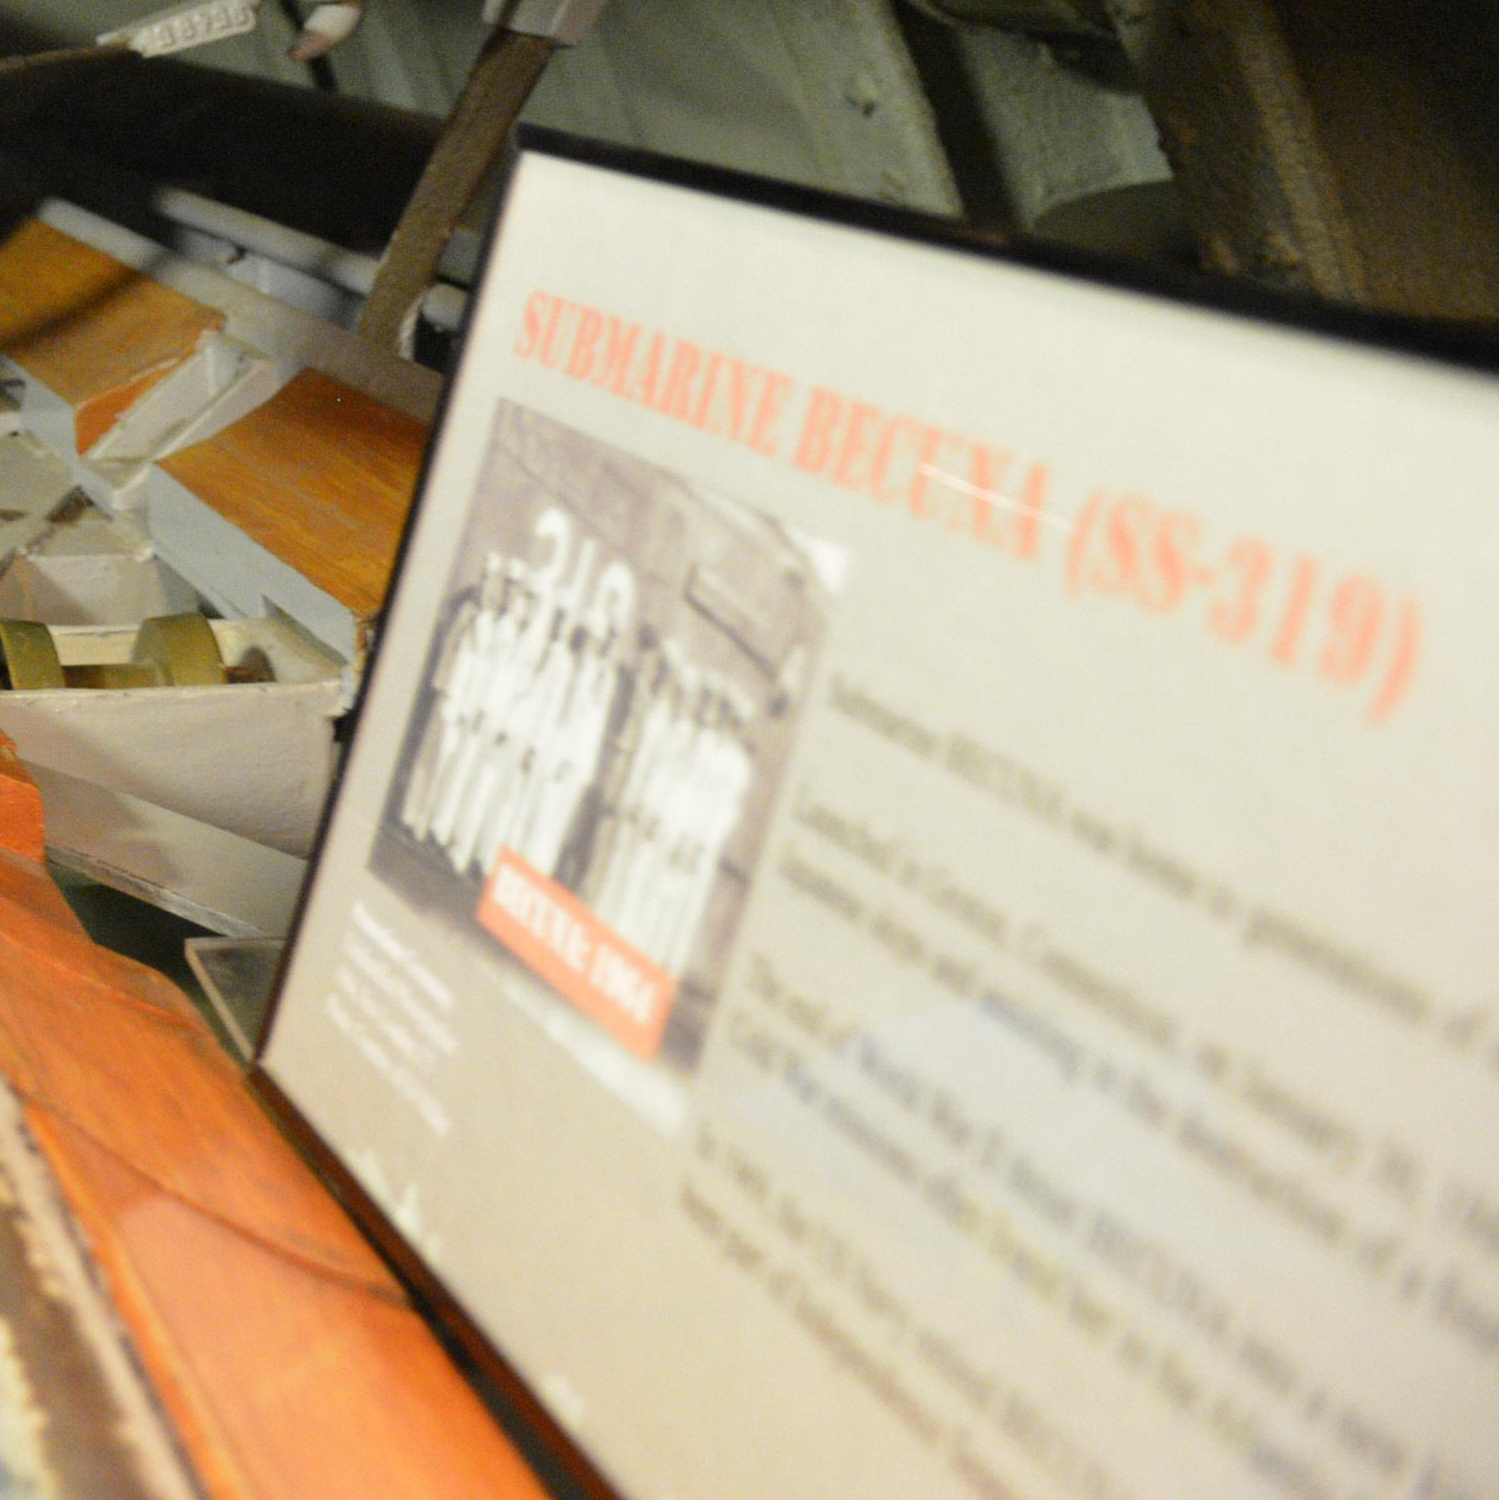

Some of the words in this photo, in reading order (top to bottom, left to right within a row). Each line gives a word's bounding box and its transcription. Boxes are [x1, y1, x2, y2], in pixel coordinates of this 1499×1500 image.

[512, 289, 794, 459] SUBMARINE
[789, 384, 1048, 566] BECUNA
[1063, 484, 1422, 730] (SS-319)
